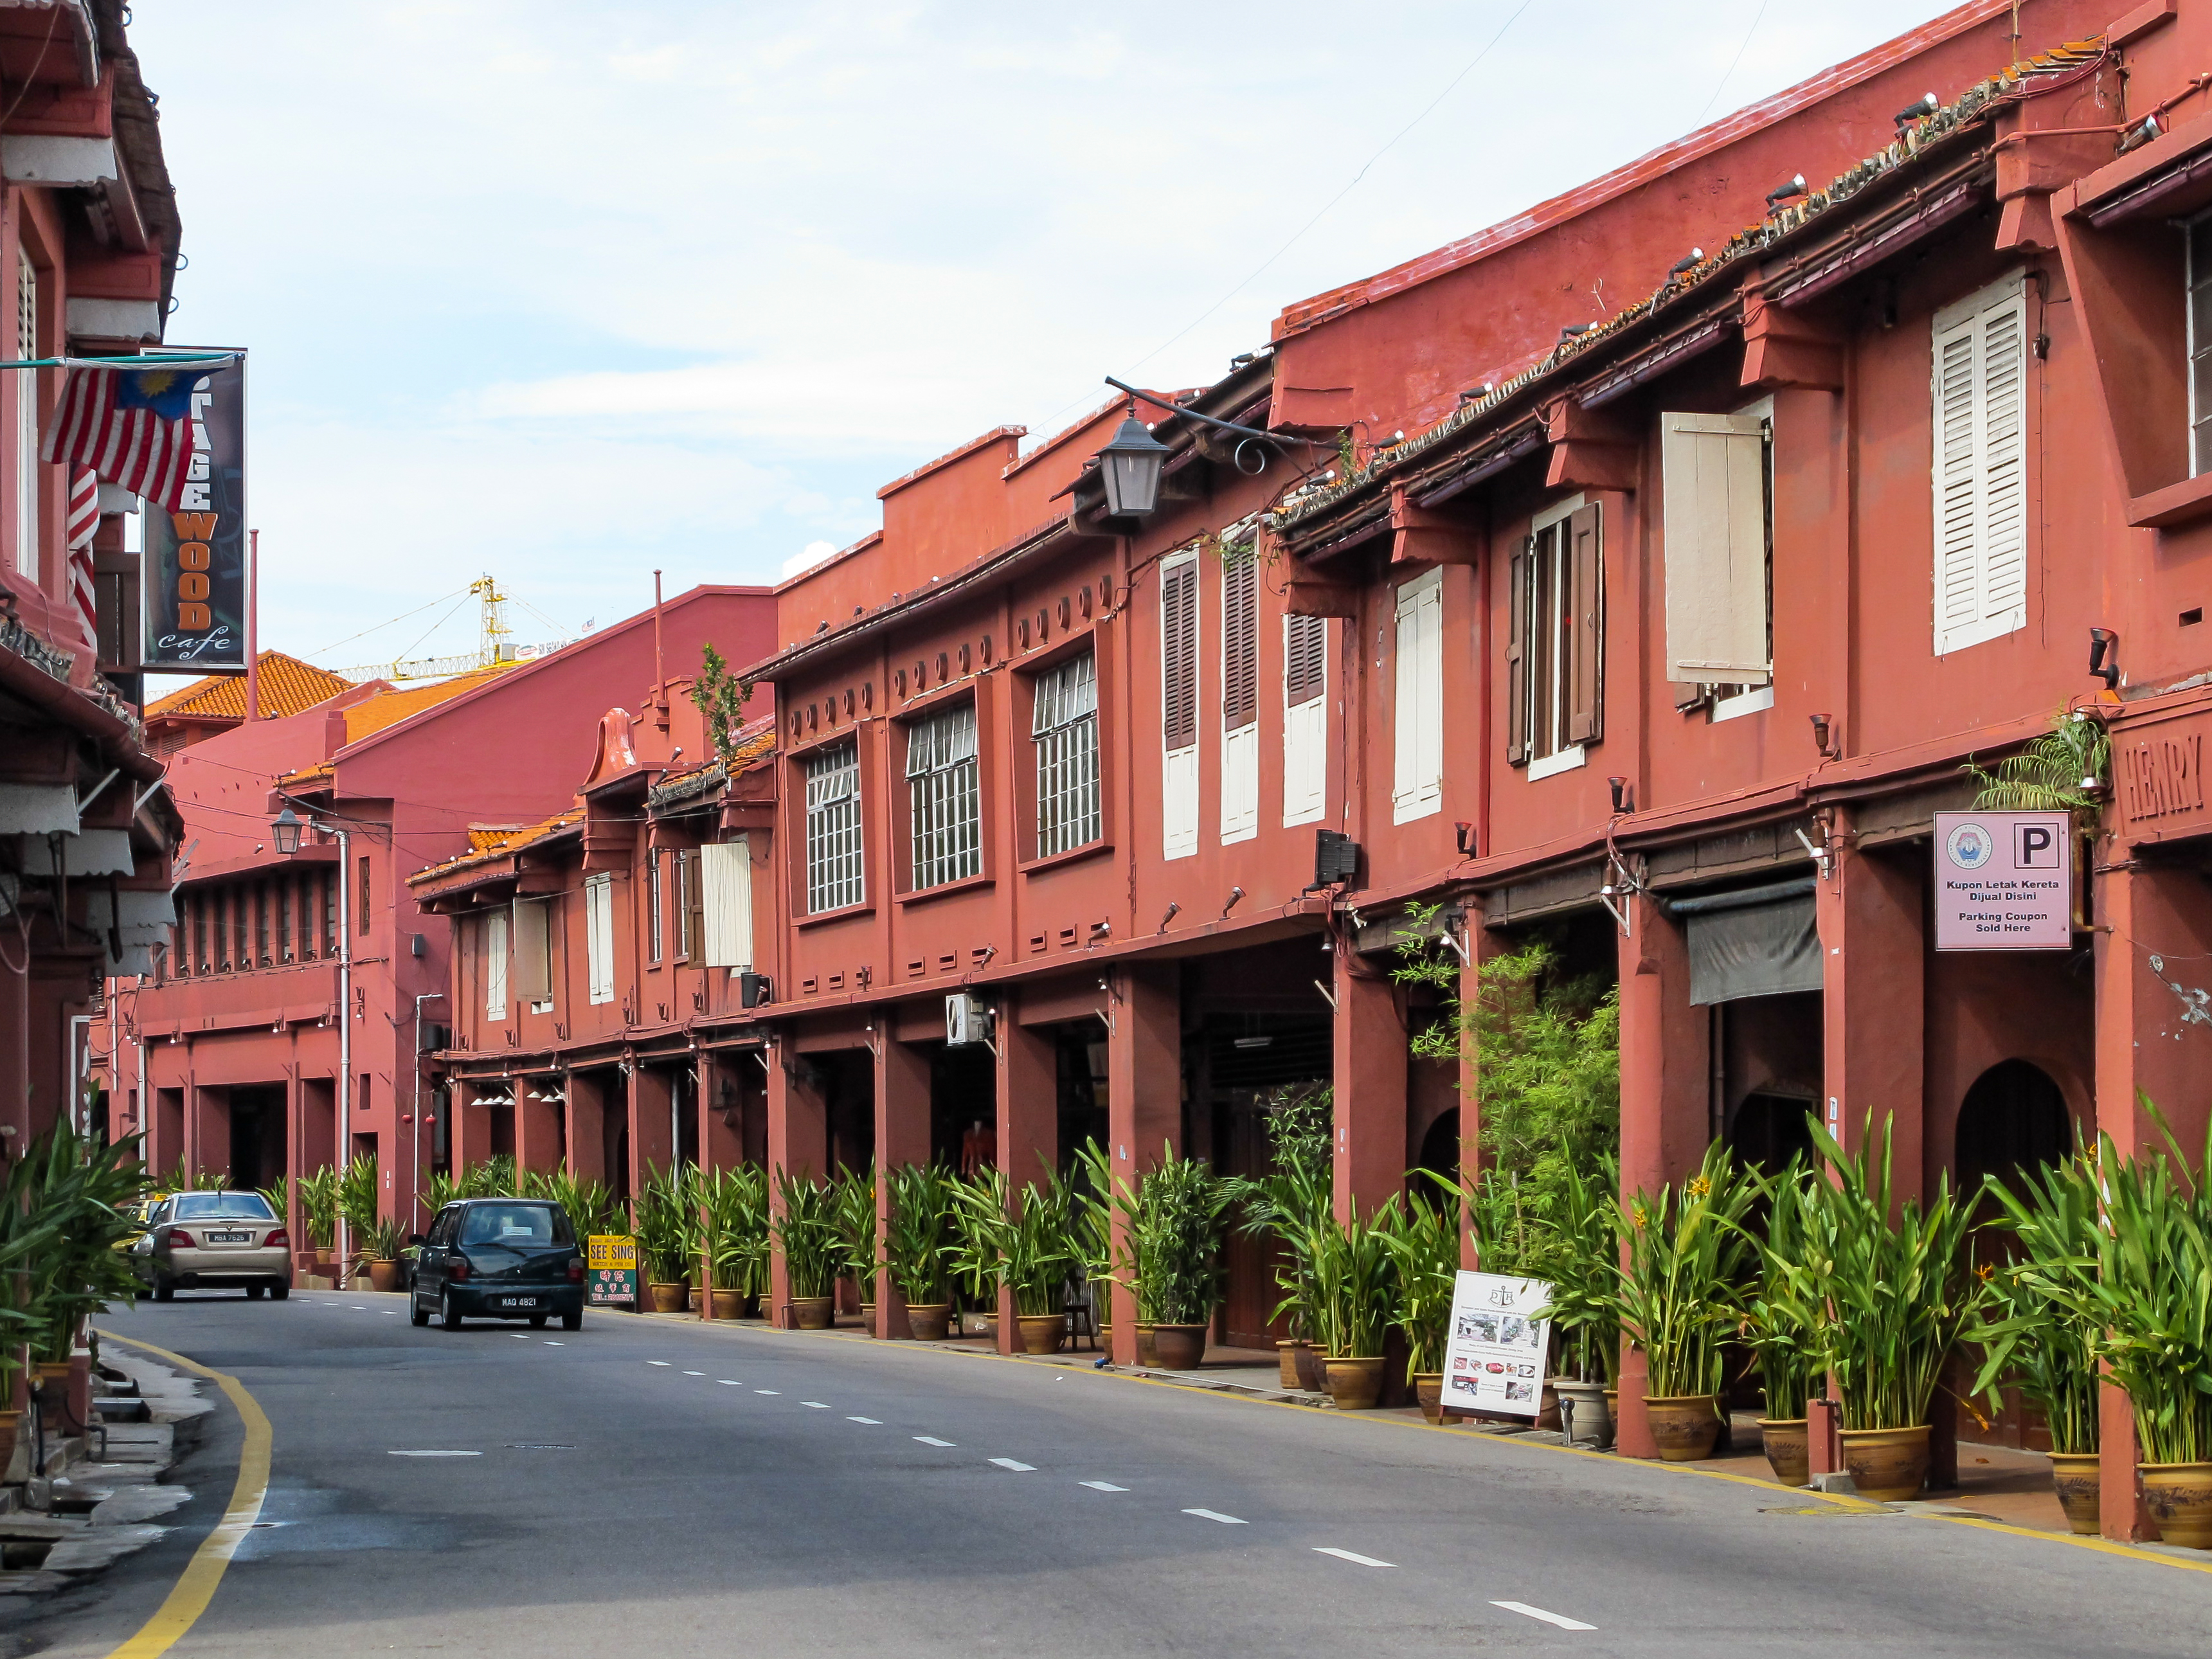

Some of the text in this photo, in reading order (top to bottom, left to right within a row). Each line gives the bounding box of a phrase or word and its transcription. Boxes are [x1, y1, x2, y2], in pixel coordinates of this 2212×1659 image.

[158, 625, 230, 659] cafe
[2023, 827, 2051, 865] P
[1947, 881, 1982, 890] Kupon
[2022, 880, 2059, 888] Kereta
[1970, 892, 2037, 902] Dijual Disini
[1959, 912, 2047, 922] Parking Coupon
[1976, 924, 2031, 932] Sold Here
[591, 1245, 633, 1259] SEE SING
